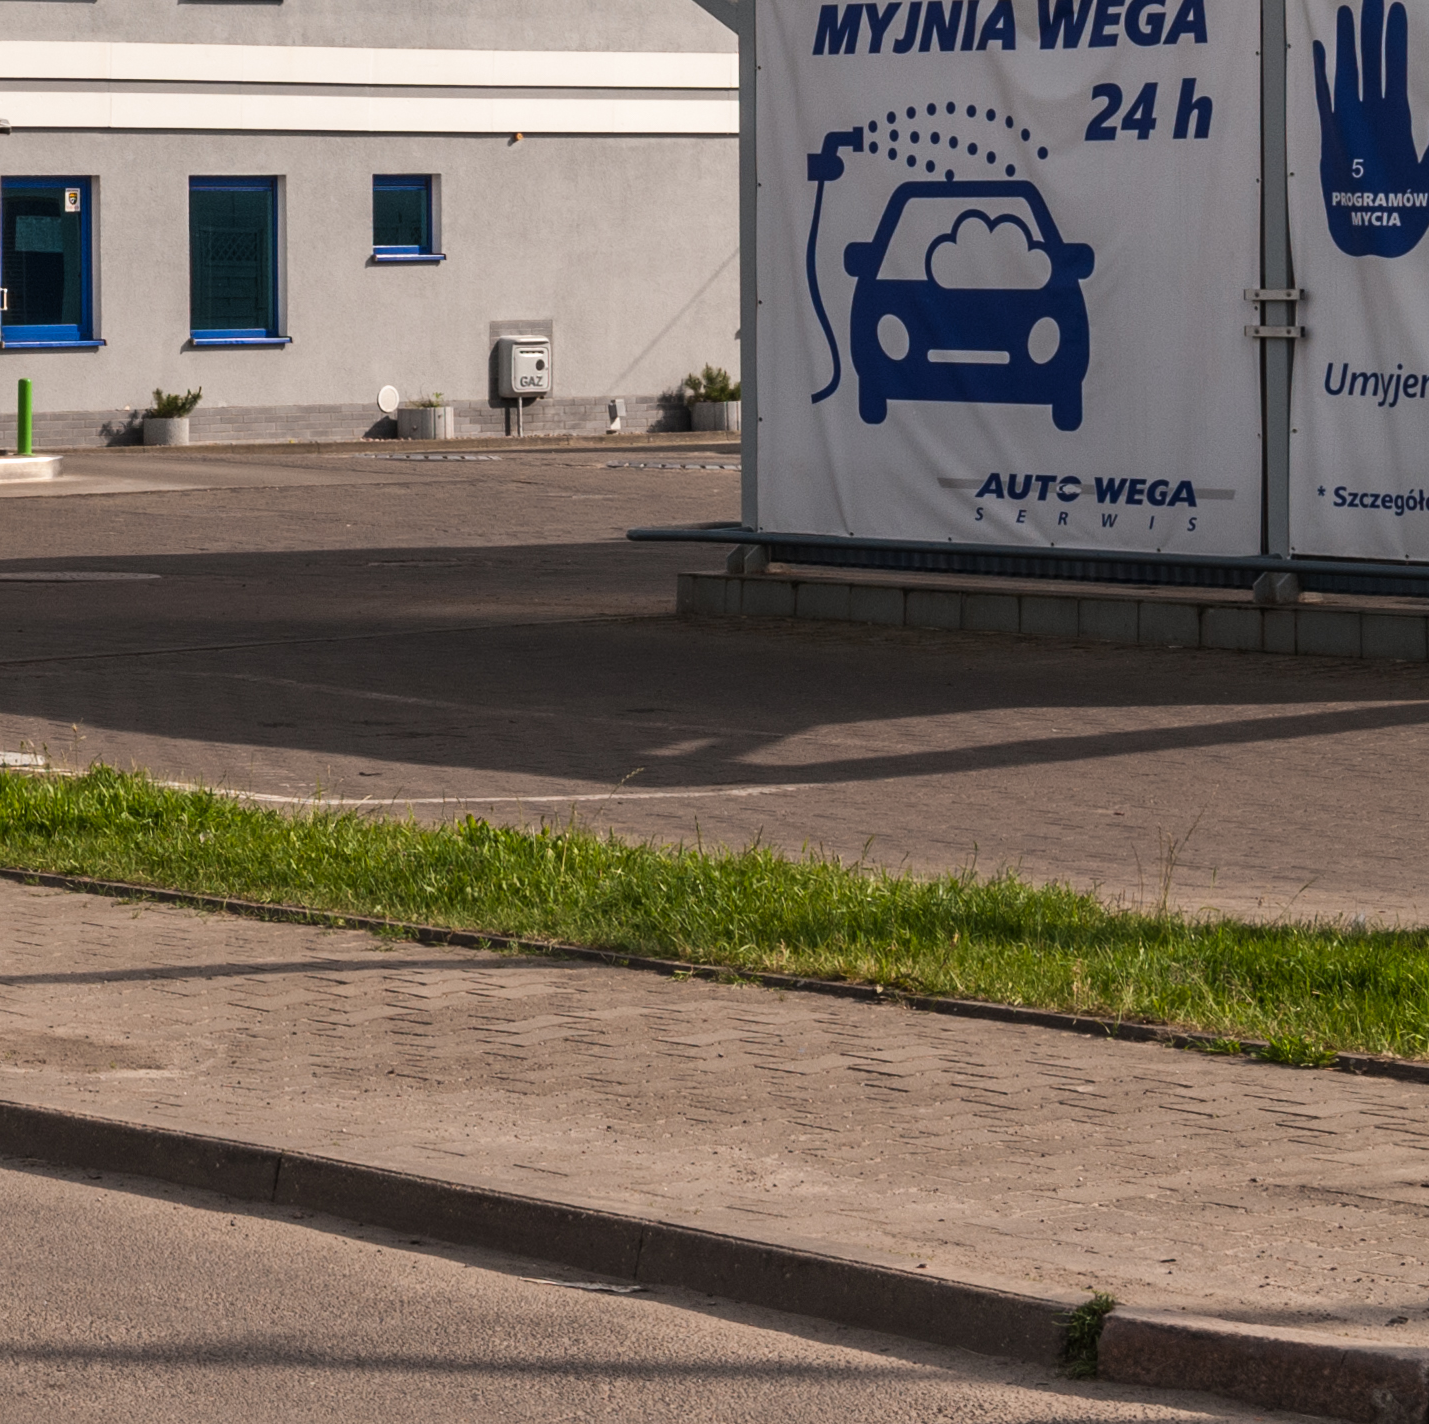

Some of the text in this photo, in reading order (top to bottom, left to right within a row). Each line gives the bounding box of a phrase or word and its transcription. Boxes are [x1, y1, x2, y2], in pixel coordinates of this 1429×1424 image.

[812, 0, 1017, 55] MYJNIA
[1084, 77, 1213, 141] 24 h
[1351, 159, 1364, 178] 5
[1332, 188, 1429, 207] PROGRAMÓW
[1351, 211, 1401, 226] MYCIA
[519, 375, 544, 388] GAZ
[975, 472, 1198, 508] AUTO WEGA
[1333, 486, 1429, 516] Szczegół
[975, 507, 1198, 532] SERWIS
